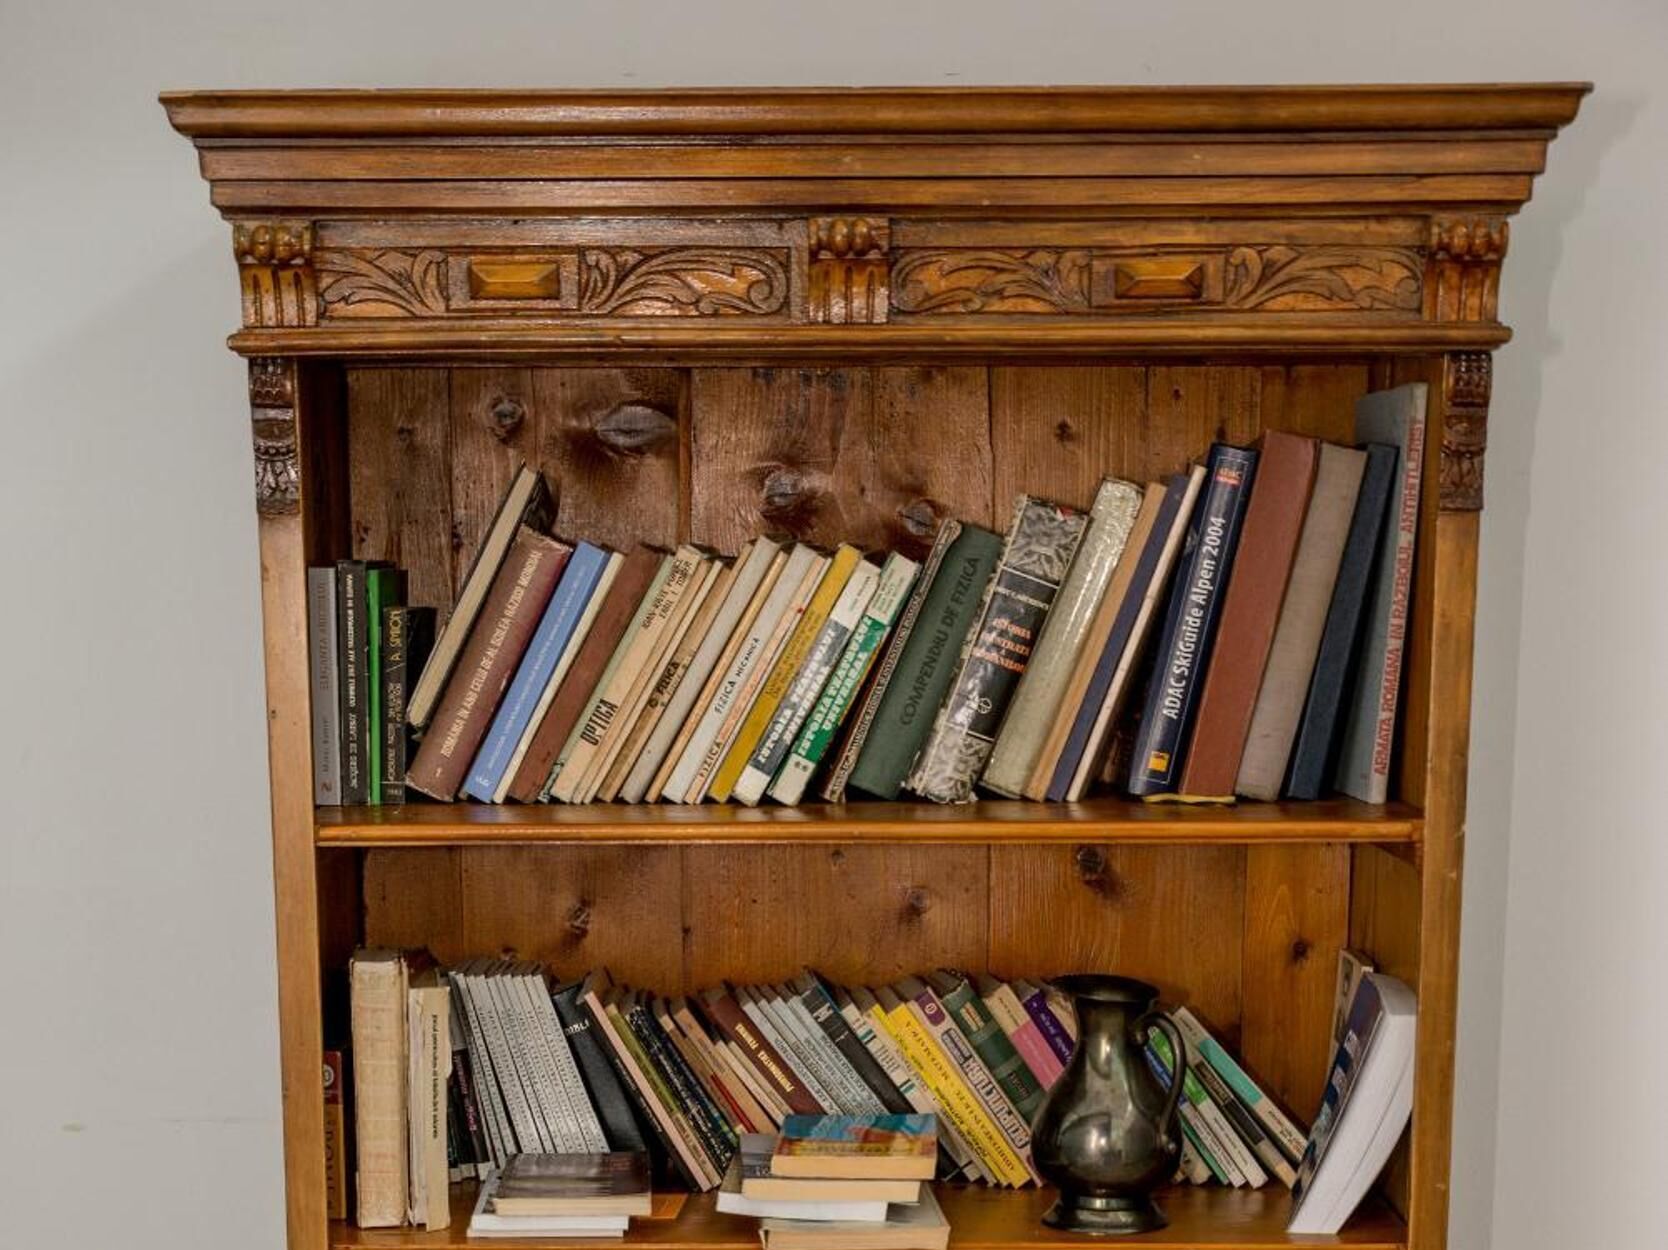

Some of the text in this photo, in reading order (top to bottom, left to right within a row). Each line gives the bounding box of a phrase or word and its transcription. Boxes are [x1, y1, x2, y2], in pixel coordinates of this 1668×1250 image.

[894, 553, 982, 727] COMPENDIU DE FIZICA
[1160, 515, 1227, 719] ADAC SkiGuide Alpen 2004
[1371, 717, 1392, 775] ARMATA
[1395, 418, 1429, 534] ANTIHITLERIST
[578, 696, 619, 748] OPTICA
[709, 678, 741, 715] FIZICA
[694, 738, 726, 779] FIZICA
